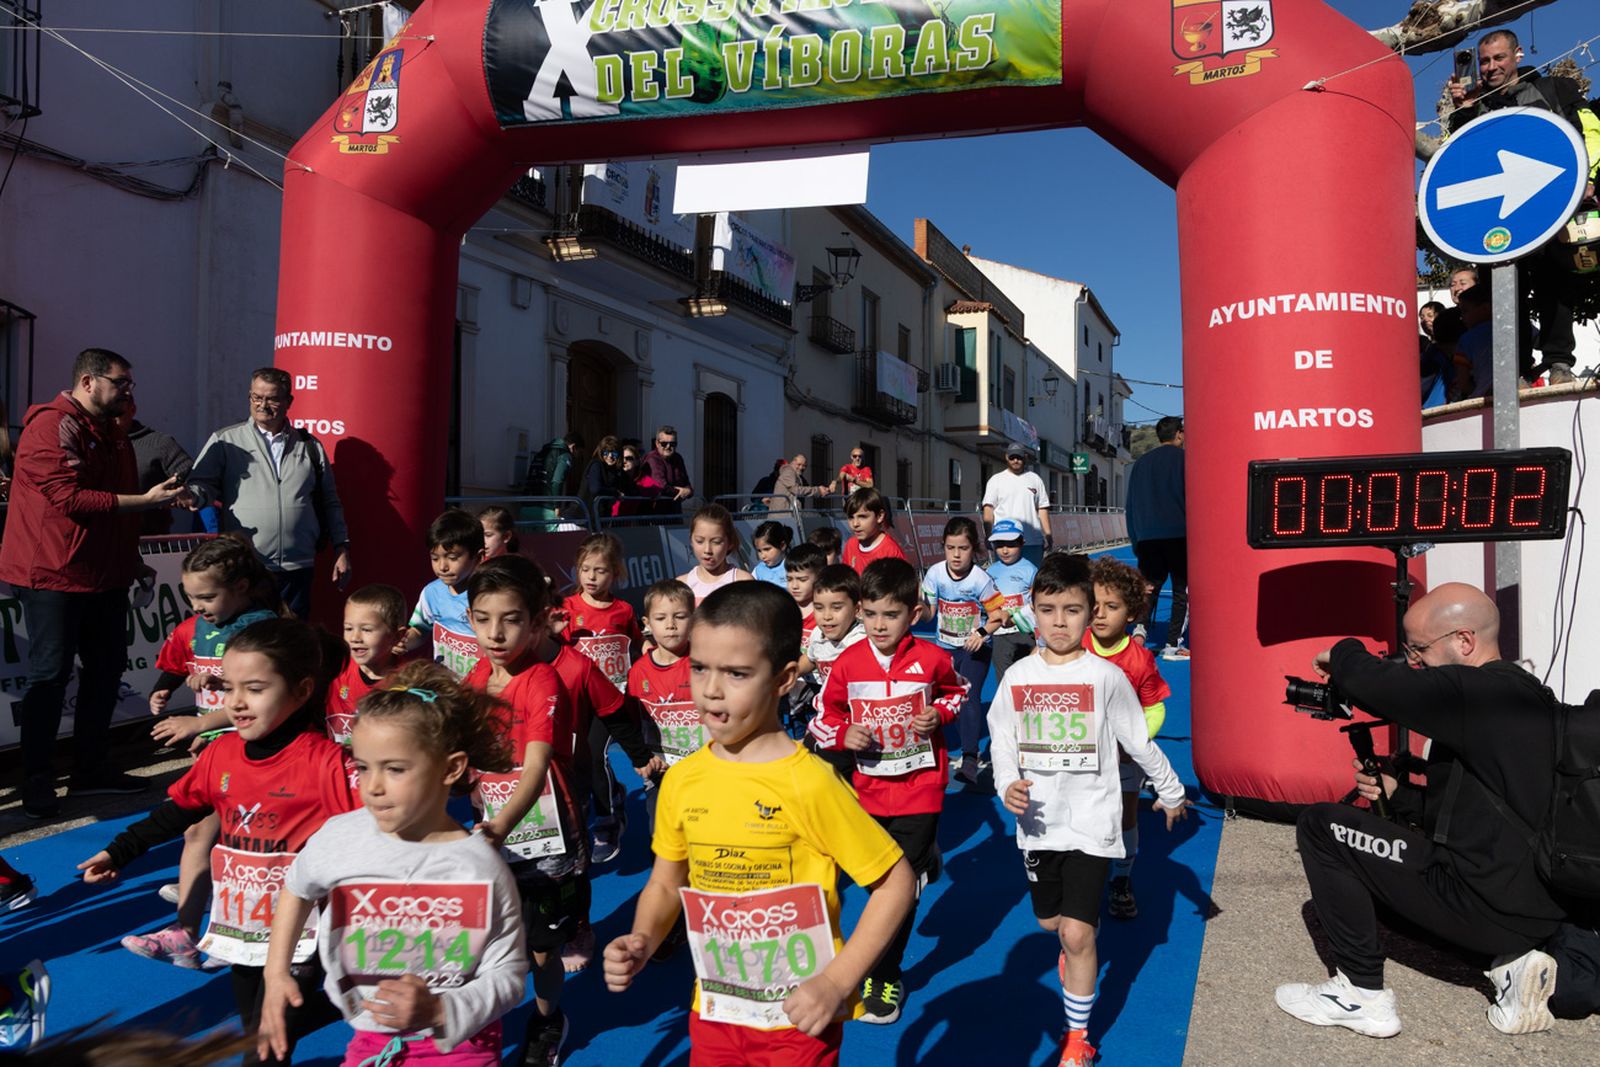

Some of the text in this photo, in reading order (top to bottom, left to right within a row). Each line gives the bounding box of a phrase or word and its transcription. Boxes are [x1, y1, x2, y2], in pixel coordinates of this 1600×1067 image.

[593, 12, 998, 104] DEL VÍBORAS
[1202, 64, 1246, 81] MARTOS
[348, 144, 378, 153] MARTOS
[1208, 292, 1407, 328] AYUNTAMIENTO
[1294, 350, 1333, 370] DE
[295, 375, 318, 390] DE
[290, 419, 345, 435] RTOS
[1254, 408, 1375, 431] MARTOS
[1273, 466, 1546, 535] 00:00:02
[580, 641, 591, 652] X
[1022, 688, 1080, 705] X CROSS
[648, 705, 700, 721] X CROSS
[861, 701, 913, 718] X CROSS
[1023, 712, 1087, 740] 1135
[481, 779, 520, 795] CROS
[1329, 822, 1408, 864] Joma
[223, 854, 234, 876] X
[219, 887, 275, 927] 114
[350, 888, 463, 917] X CROSS
[698, 898, 798, 929] X CROSS
[703, 923, 782, 943] PANTANO
[345, 927, 476, 971] 1214
[704, 932, 816, 983] 1170
